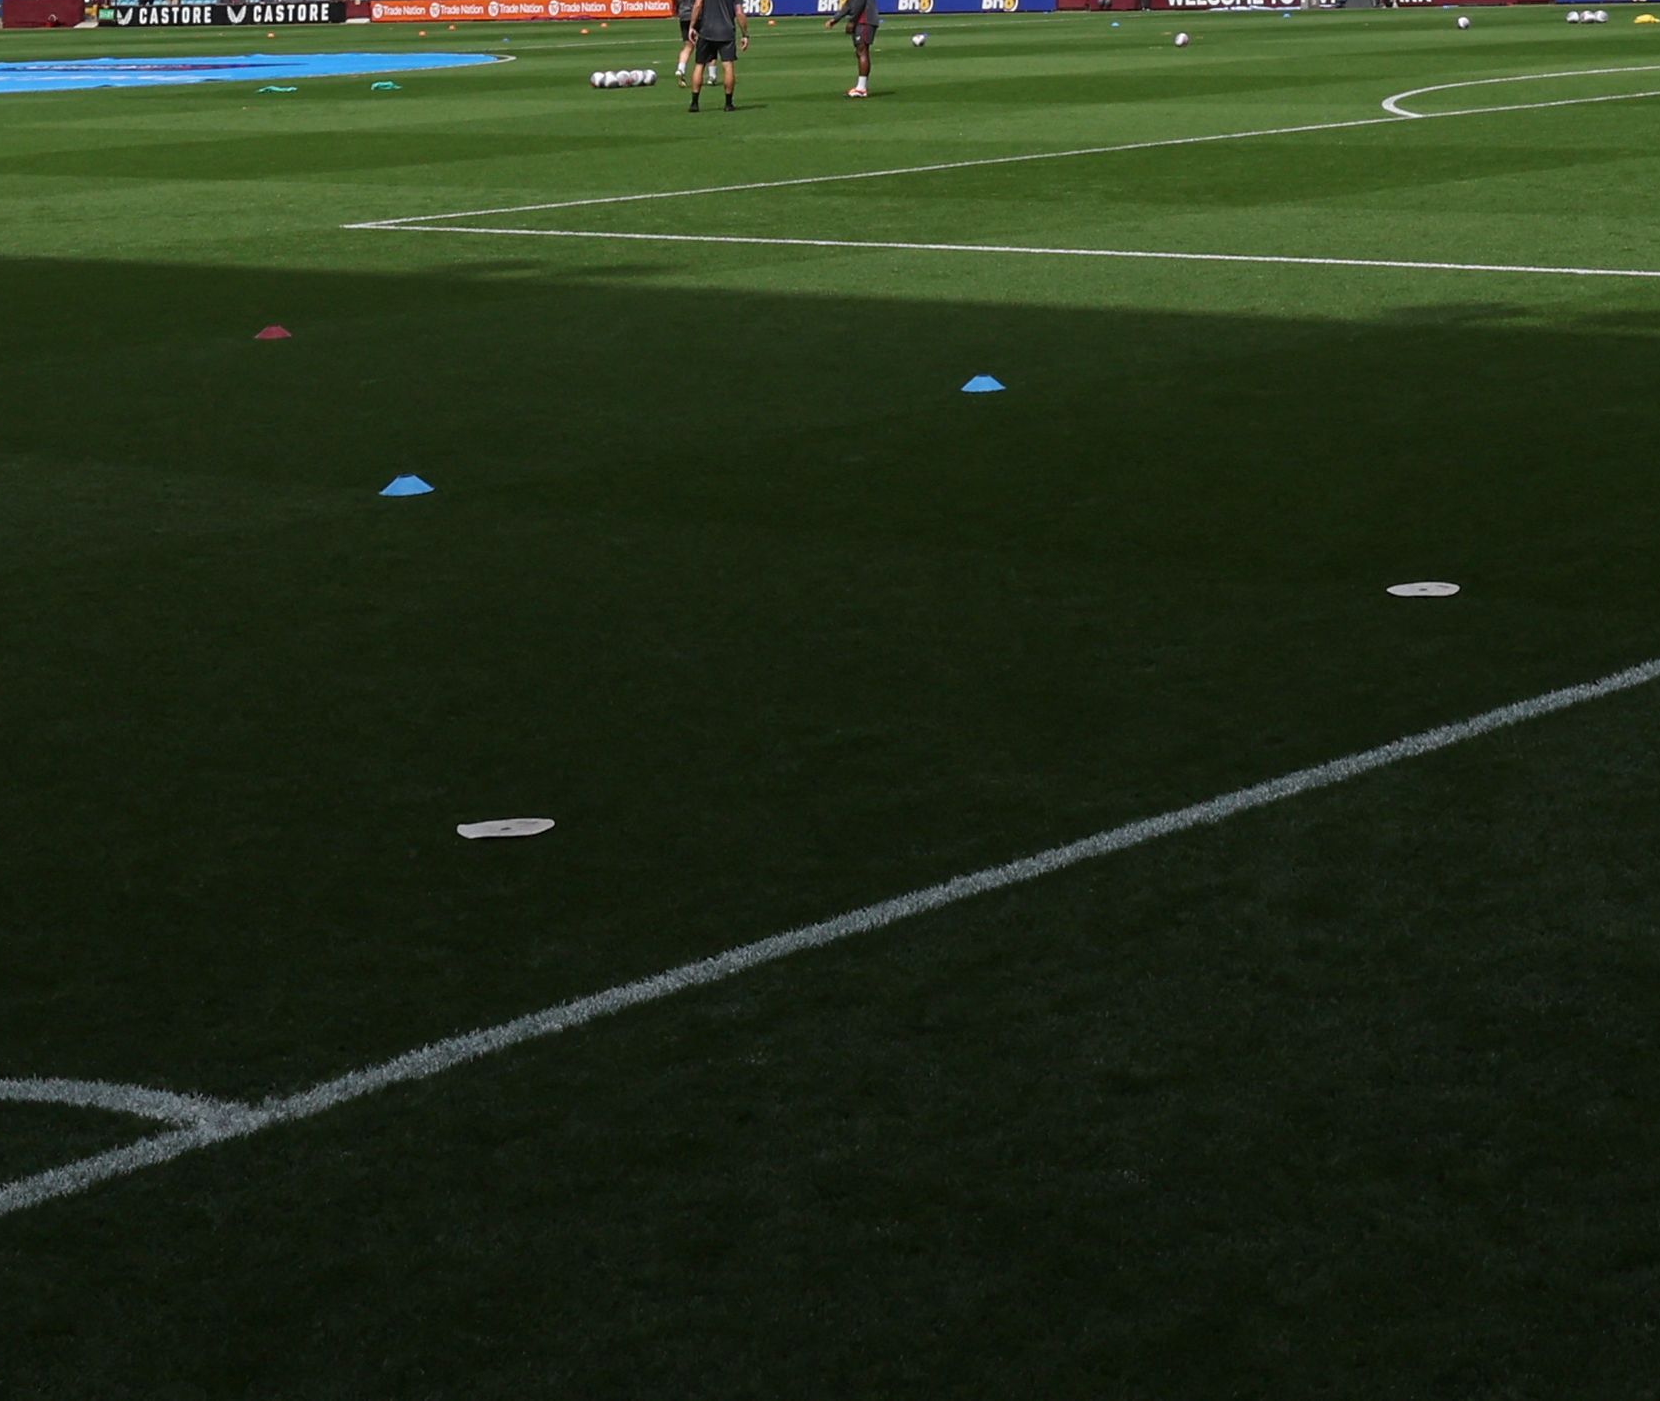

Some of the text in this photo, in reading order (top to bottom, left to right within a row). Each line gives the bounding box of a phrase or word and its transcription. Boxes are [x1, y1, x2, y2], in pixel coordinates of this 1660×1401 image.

[139, 2, 330, 25] CASTORE CASTORE
[383, 0, 670, 15] Trade Nation Trade Nation Trade Nation Trade Nation Trade Nation
